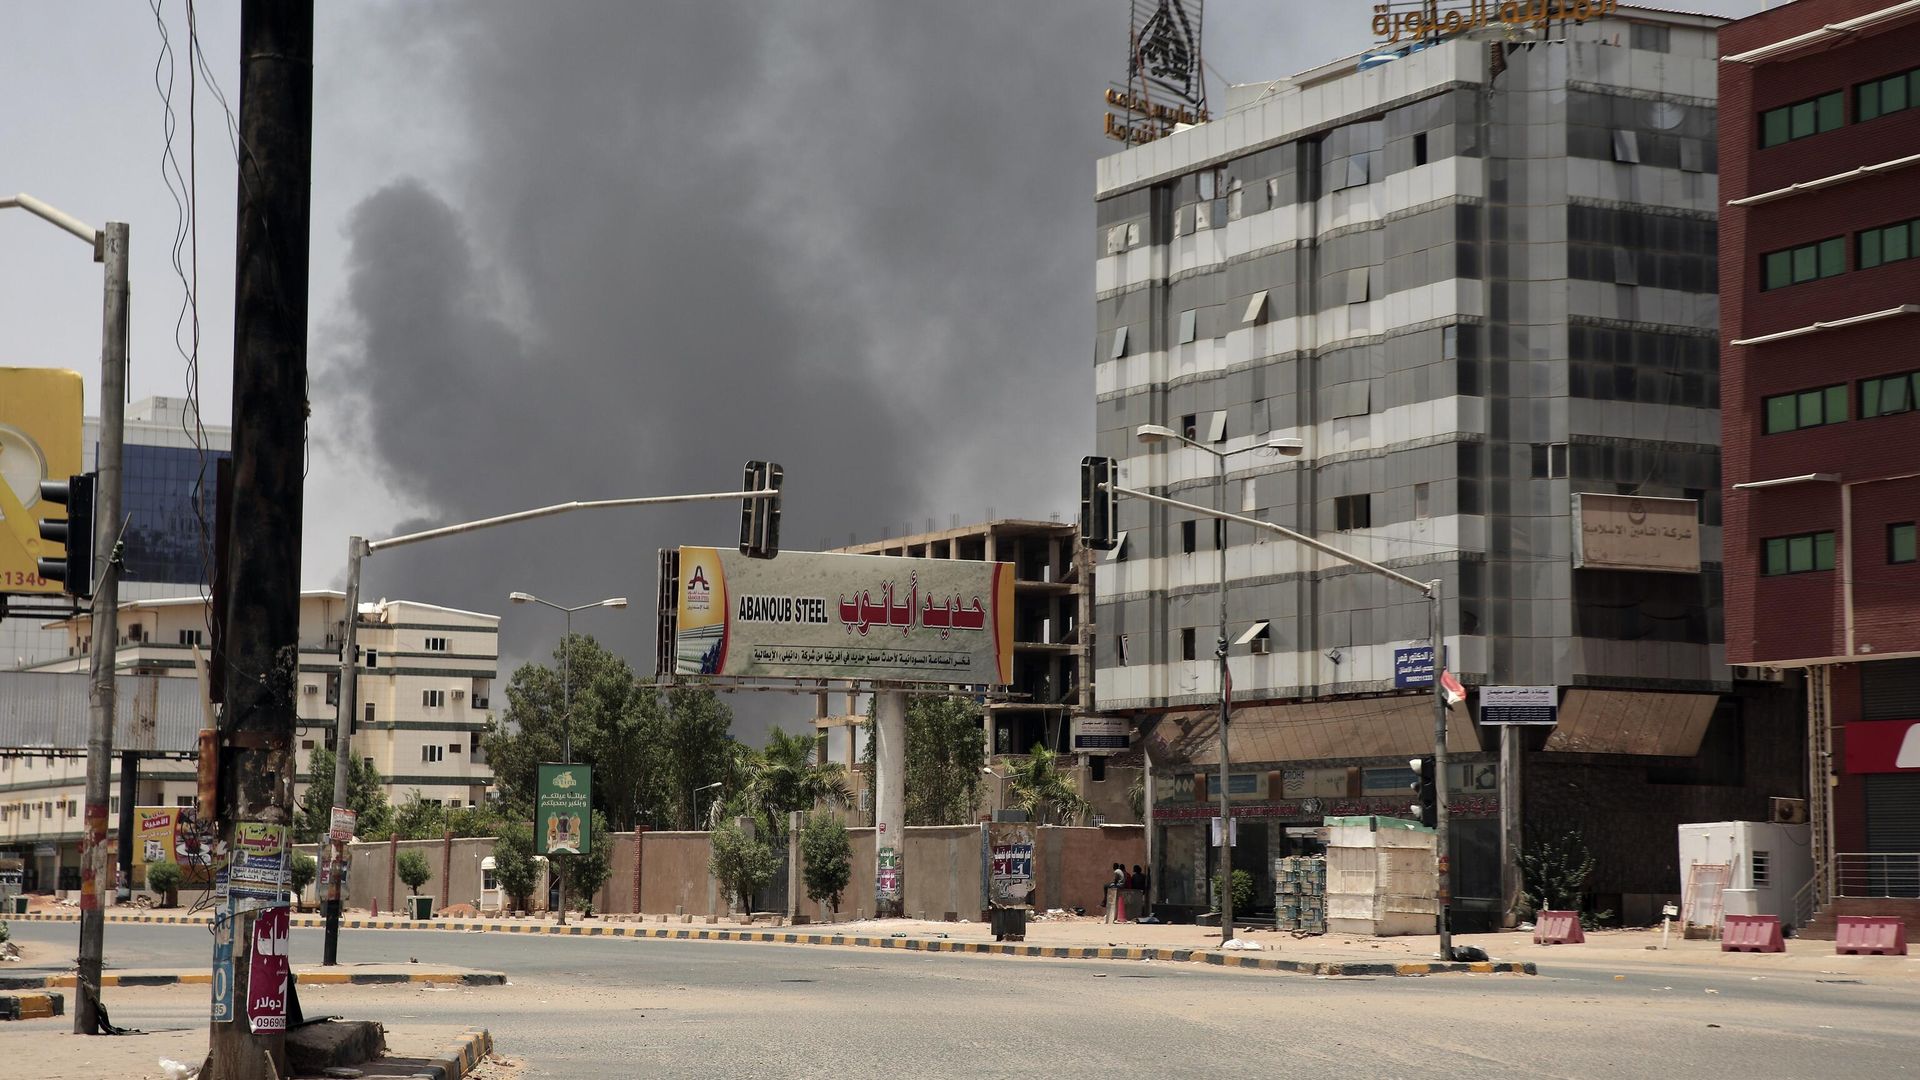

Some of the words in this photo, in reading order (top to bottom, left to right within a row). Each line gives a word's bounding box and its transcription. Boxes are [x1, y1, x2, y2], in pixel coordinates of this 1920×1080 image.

[1664, 528, 1692, 541] شركة
[738, 596, 792, 622] ABANOUB
[794, 598, 828, 623] STEEL
[838, 569, 919, 637] أبانوب
[921, 592, 986, 640] حديد
[253, 996, 282, 1010] دولار
